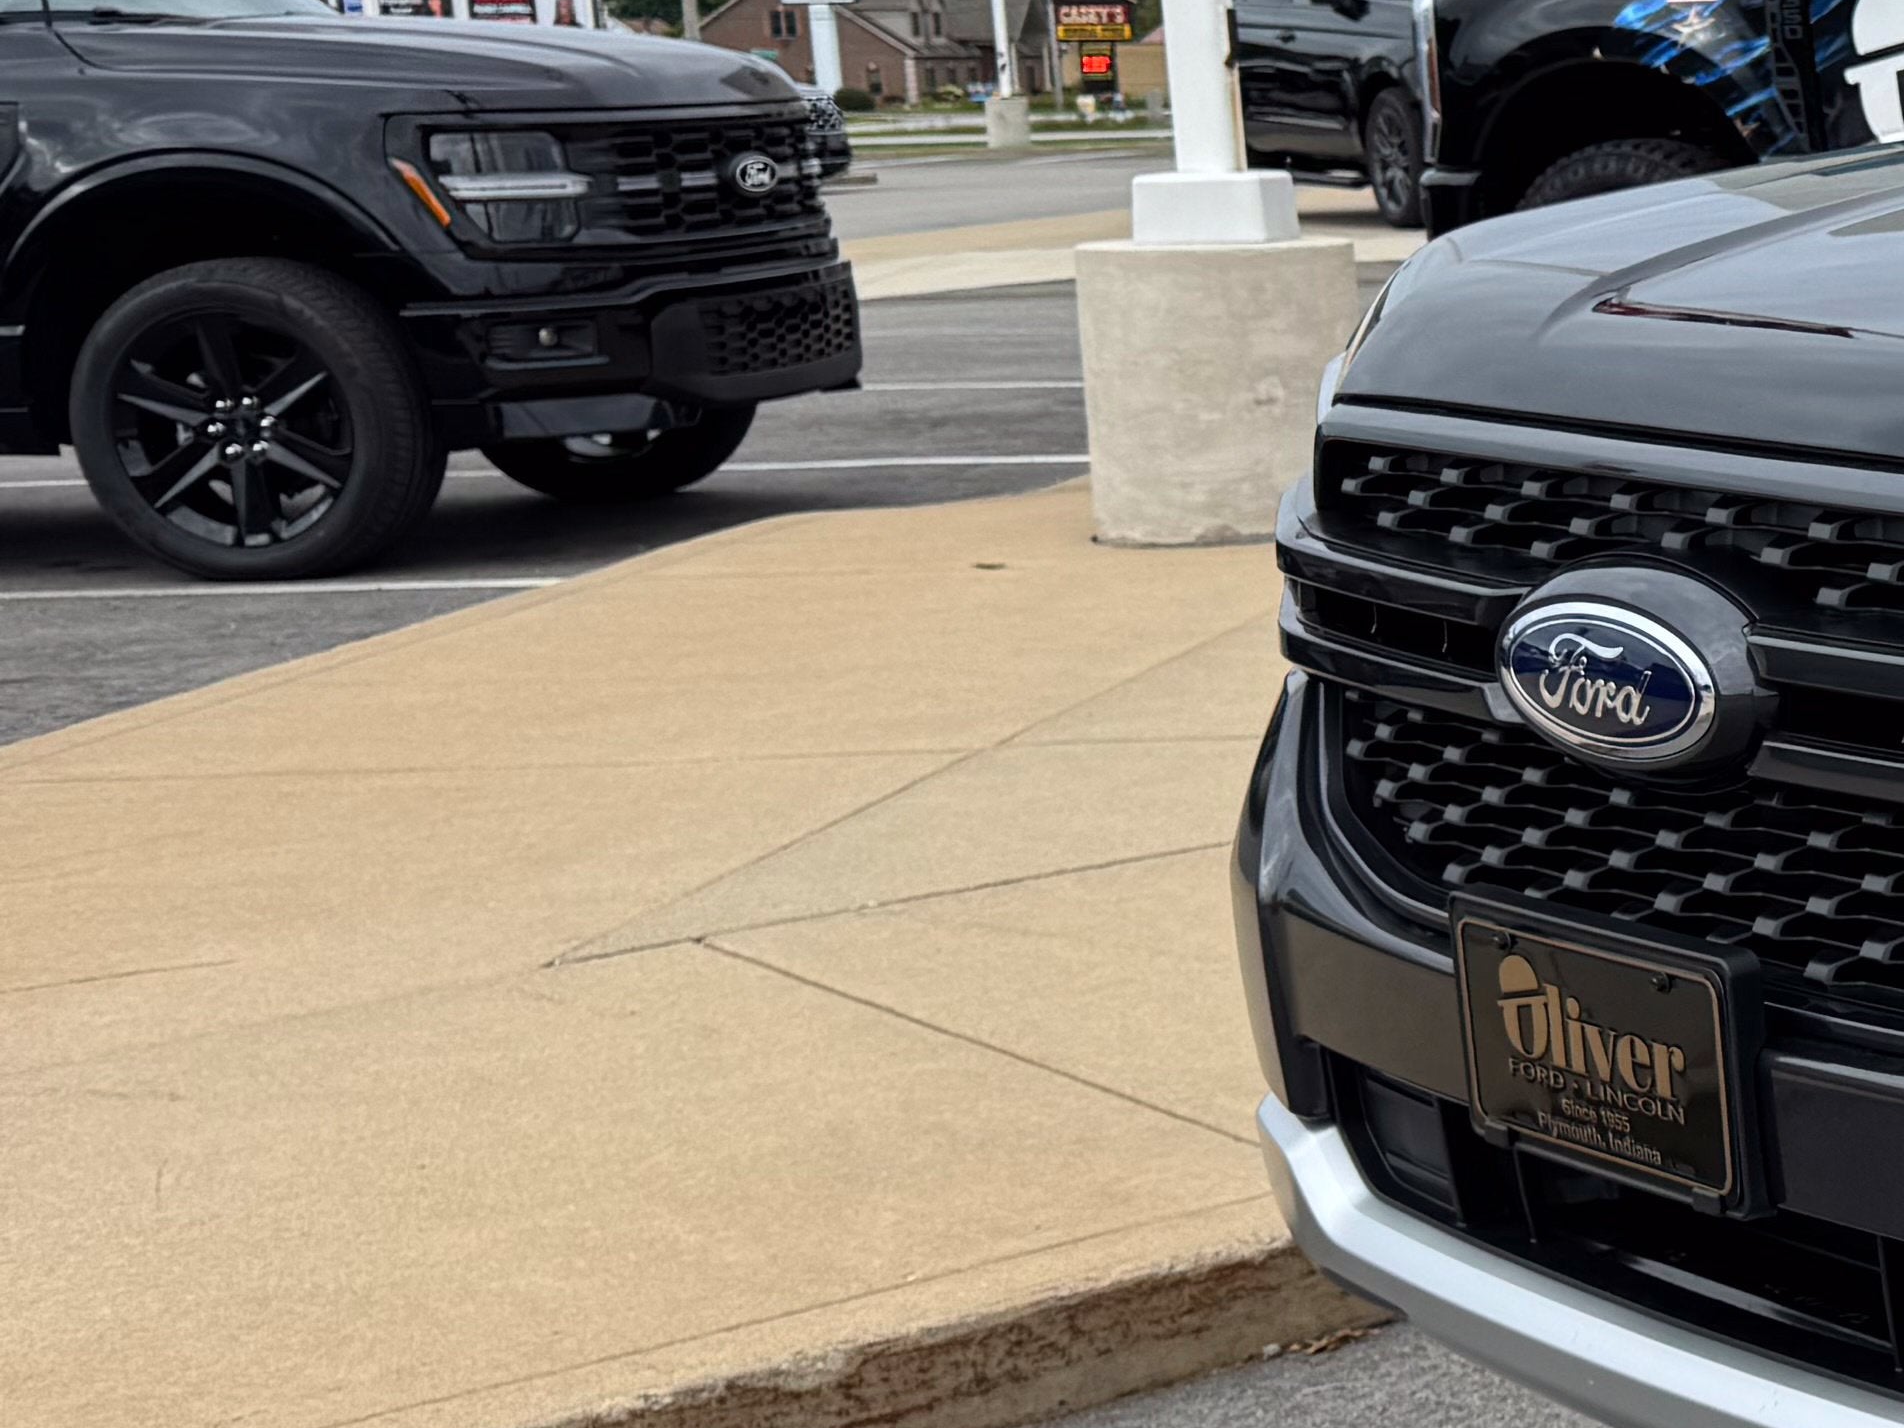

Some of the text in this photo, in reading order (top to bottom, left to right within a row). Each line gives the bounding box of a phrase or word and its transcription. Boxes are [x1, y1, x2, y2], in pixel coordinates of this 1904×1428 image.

[1539, 632, 1652, 725] Ford
[1497, 954, 1687, 1101] Oliver
[1509, 1058, 1685, 1125] FORD LINCOLN
[1609, 1133, 1662, 1165] Indiana
